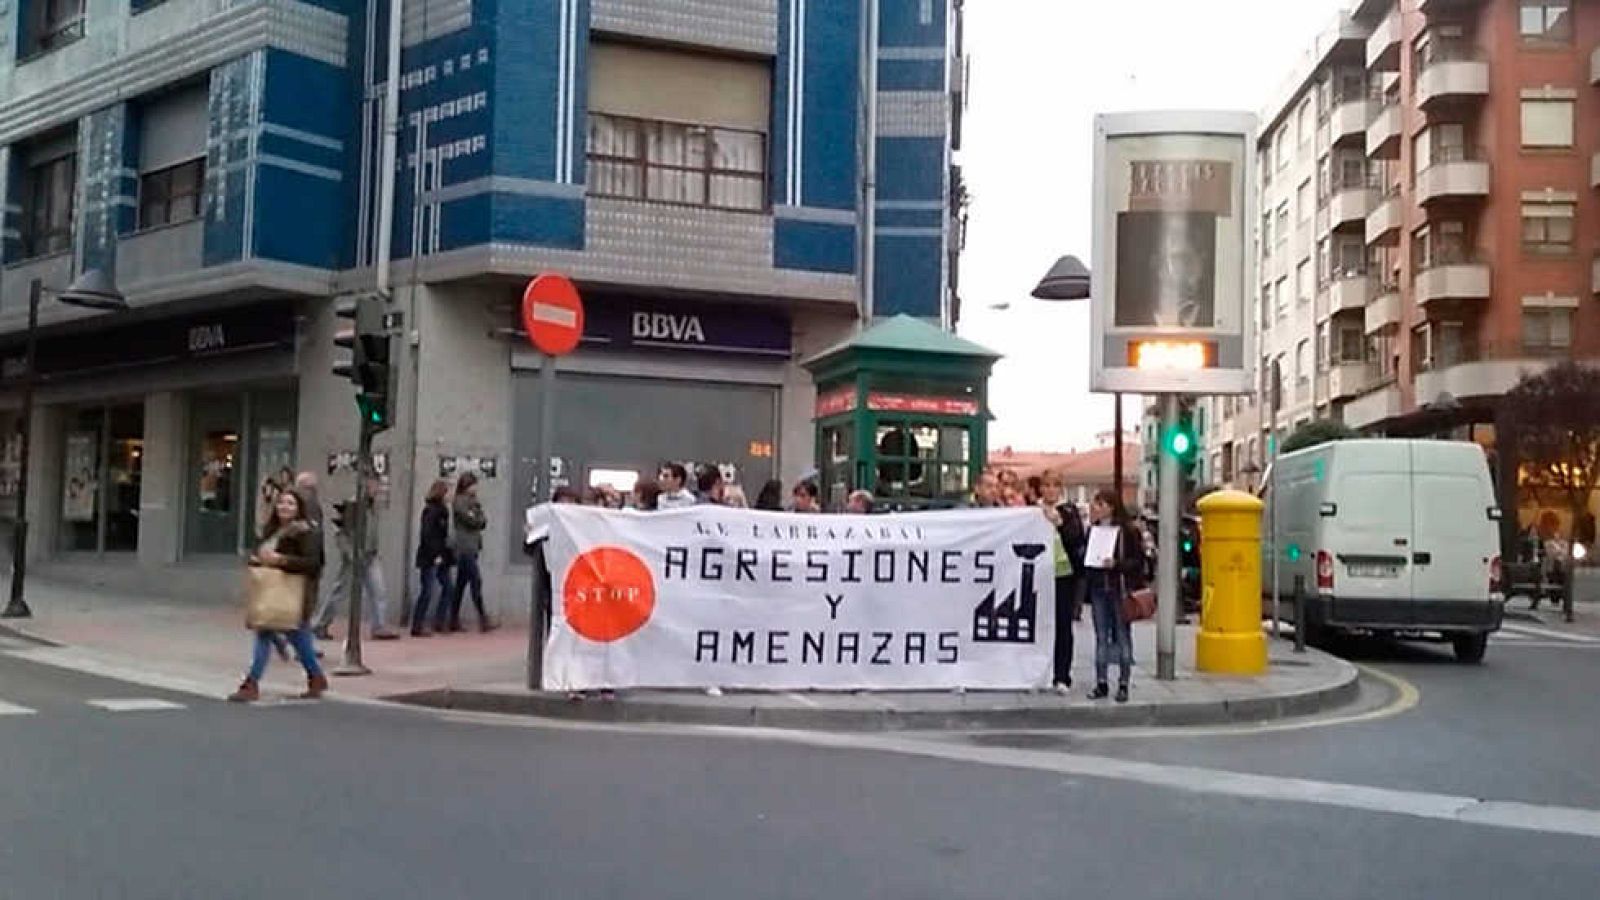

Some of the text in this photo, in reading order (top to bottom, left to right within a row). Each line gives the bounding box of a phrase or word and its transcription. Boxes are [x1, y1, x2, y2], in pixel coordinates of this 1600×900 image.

[632, 312, 705, 341] BBVA
[753, 523, 925, 540] LARRAZABAL
[665, 547, 996, 583] AGRESIONES
[575, 586, 639, 602] STOP
[825, 593, 843, 619] Y
[695, 630, 961, 664] AMENAZAS
